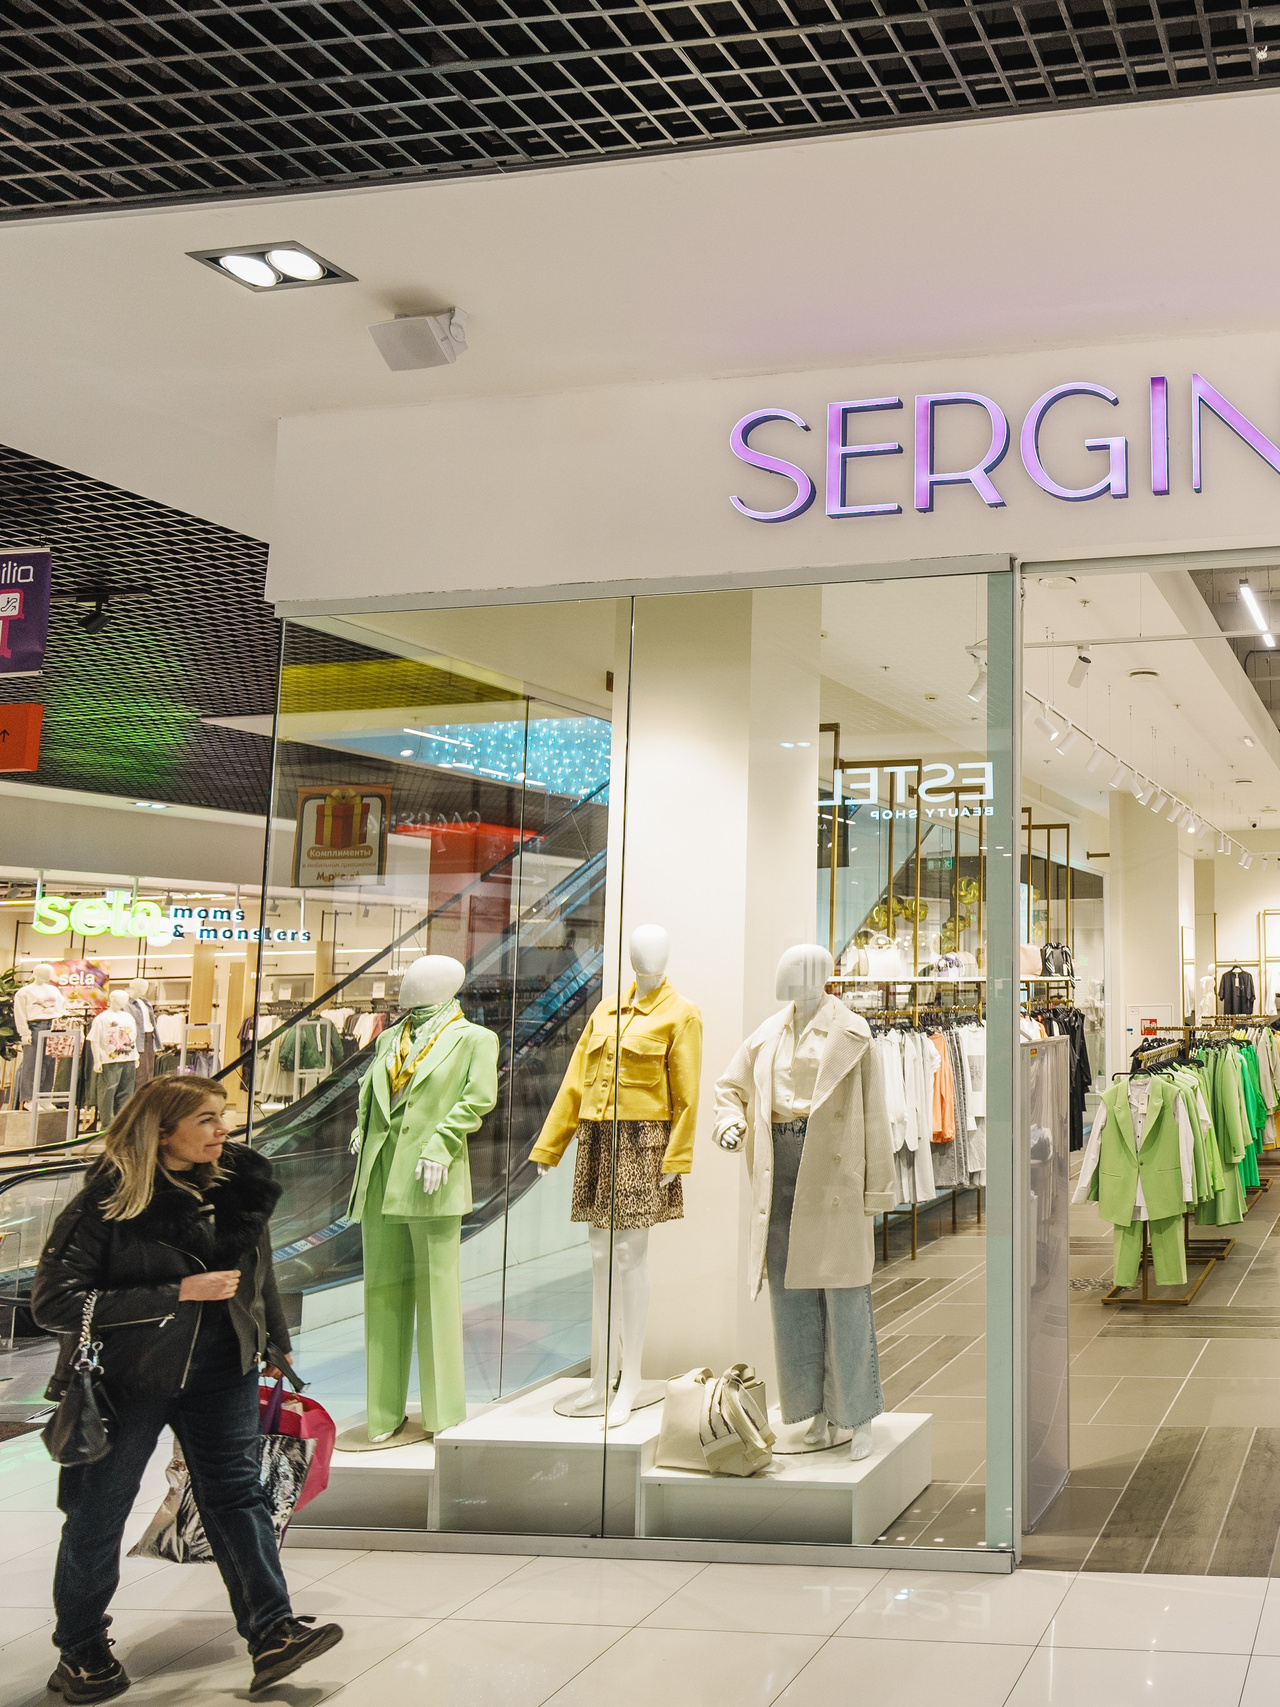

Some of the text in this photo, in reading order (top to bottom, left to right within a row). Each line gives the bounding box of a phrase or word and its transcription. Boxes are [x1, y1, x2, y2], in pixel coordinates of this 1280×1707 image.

[310, 849, 370, 857] Комплименты
[33, 891, 163, 937] sela
[173, 905, 245, 922] moms
[199, 926, 311, 942] monsters
[58, 971, 96, 986] sela
